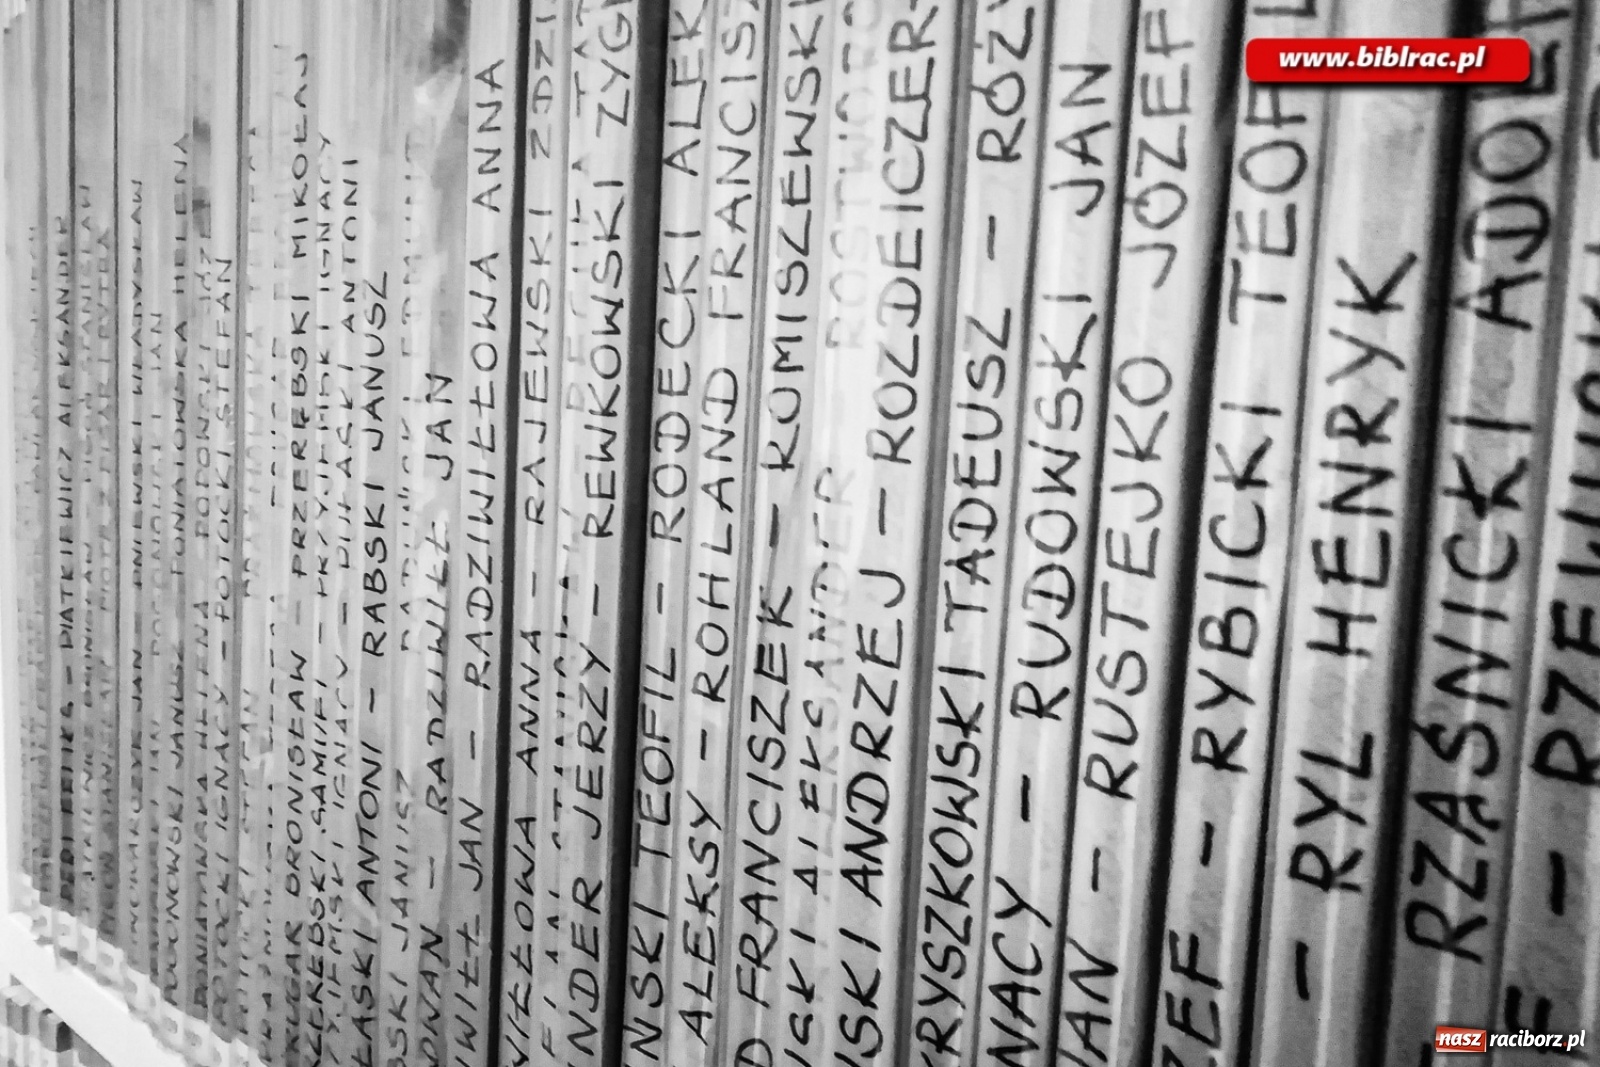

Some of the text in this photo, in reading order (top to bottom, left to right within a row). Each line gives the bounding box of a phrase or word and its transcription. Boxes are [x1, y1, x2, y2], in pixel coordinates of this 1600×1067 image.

[471, 58, 505, 213] ANNA
[663, 0, 708, 177] ALEK
[1048, 62, 1113, 217] JAN
[1123, 7, 1195, 290] JÓZEF
[1227, 0, 1317, 327] TEOFL
[215, 258, 232, 428] STEFAN
[360, 271, 387, 452] JANUSZ
[424, 372, 453, 481] JAN
[464, 252, 500, 690] RADZIWIŁŁOWA
[522, 208, 553, 525] RAJEWSKI
[581, 179, 625, 539] REWKOWSKI
[650, 229, 701, 543] RODECKI
[942, 307, 1013, 634] TADEUSZ
[1304, 251, 1418, 659] HENRYK
[213, 450, 231, 623] POTOCKI
[361, 482, 387, 658] RABSKI
[690, 366, 739, 704] ROHLAND
[1009, 293, 1099, 722] RUDOWSKI
[1082, 356, 1173, 802] RUSTEJKO
[1190, 400, 1282, 775] RYBICKI
[355, 740, 382, 907] ANTONI
[515, 629, 541, 776] ANNA
[572, 641, 611, 841] JERZY
[633, 647, 676, 868] TEOFIL
[735, 585, 793, 1010] FRANCISZEK
[839, 567, 906, 908] ANDRZEJ
[1288, 733, 1375, 894] RYL
[1403, 411, 1534, 965] RZĄŚNICKI
[457, 796, 484, 891] JAN
[677, 789, 722, 1047] ALEKSY
[914, 666, 987, 1067] RYSZKOWSKI
